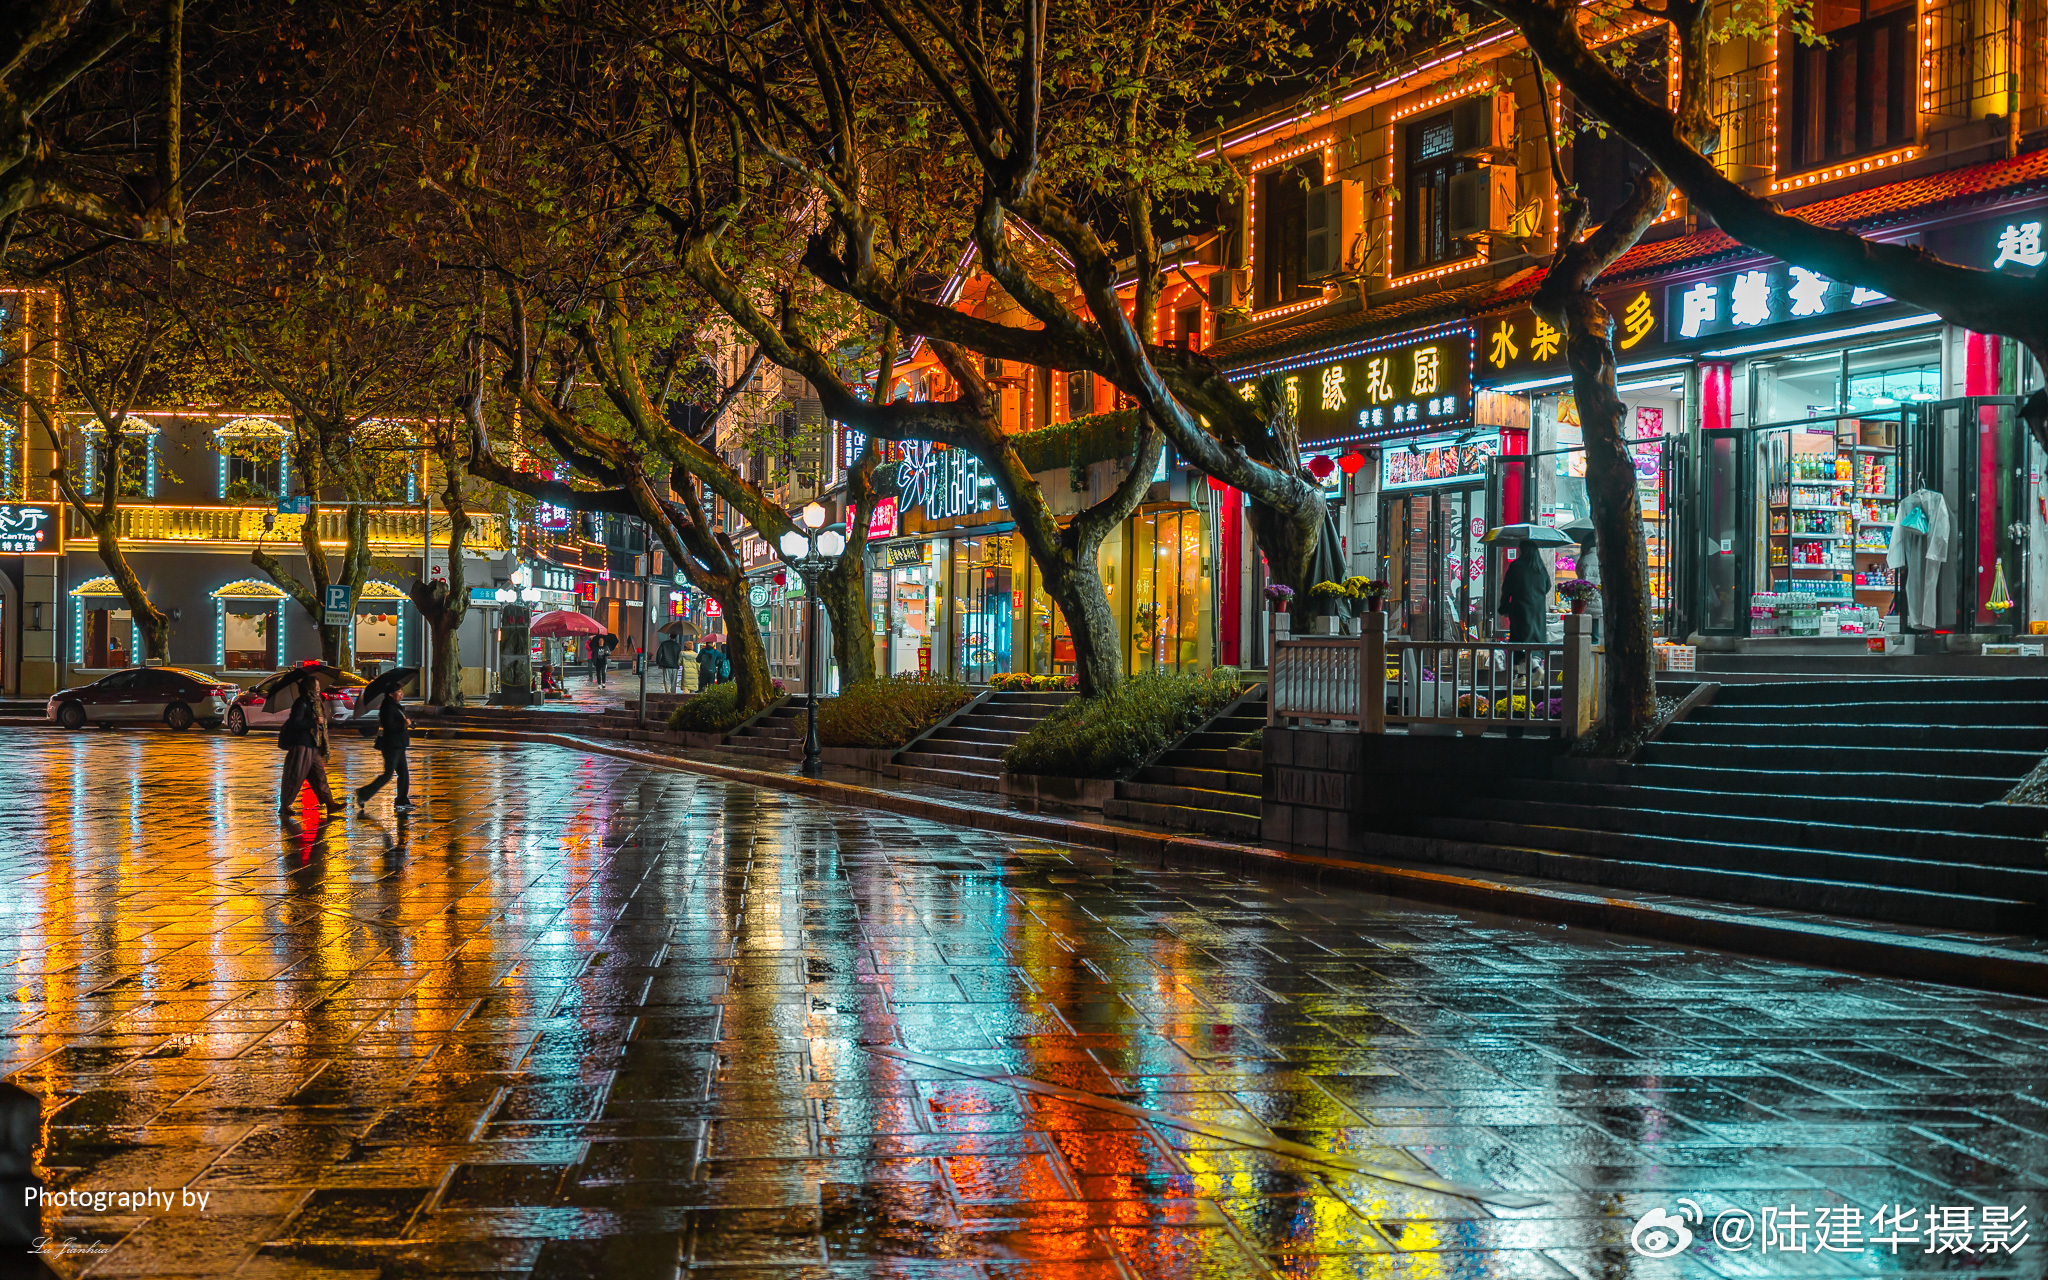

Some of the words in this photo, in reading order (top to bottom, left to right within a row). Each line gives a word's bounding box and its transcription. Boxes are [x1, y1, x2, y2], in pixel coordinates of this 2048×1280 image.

[1993, 221, 2047, 269] 超
[1489, 290, 1655, 369] 水果多
[328, 588, 345, 609] P
